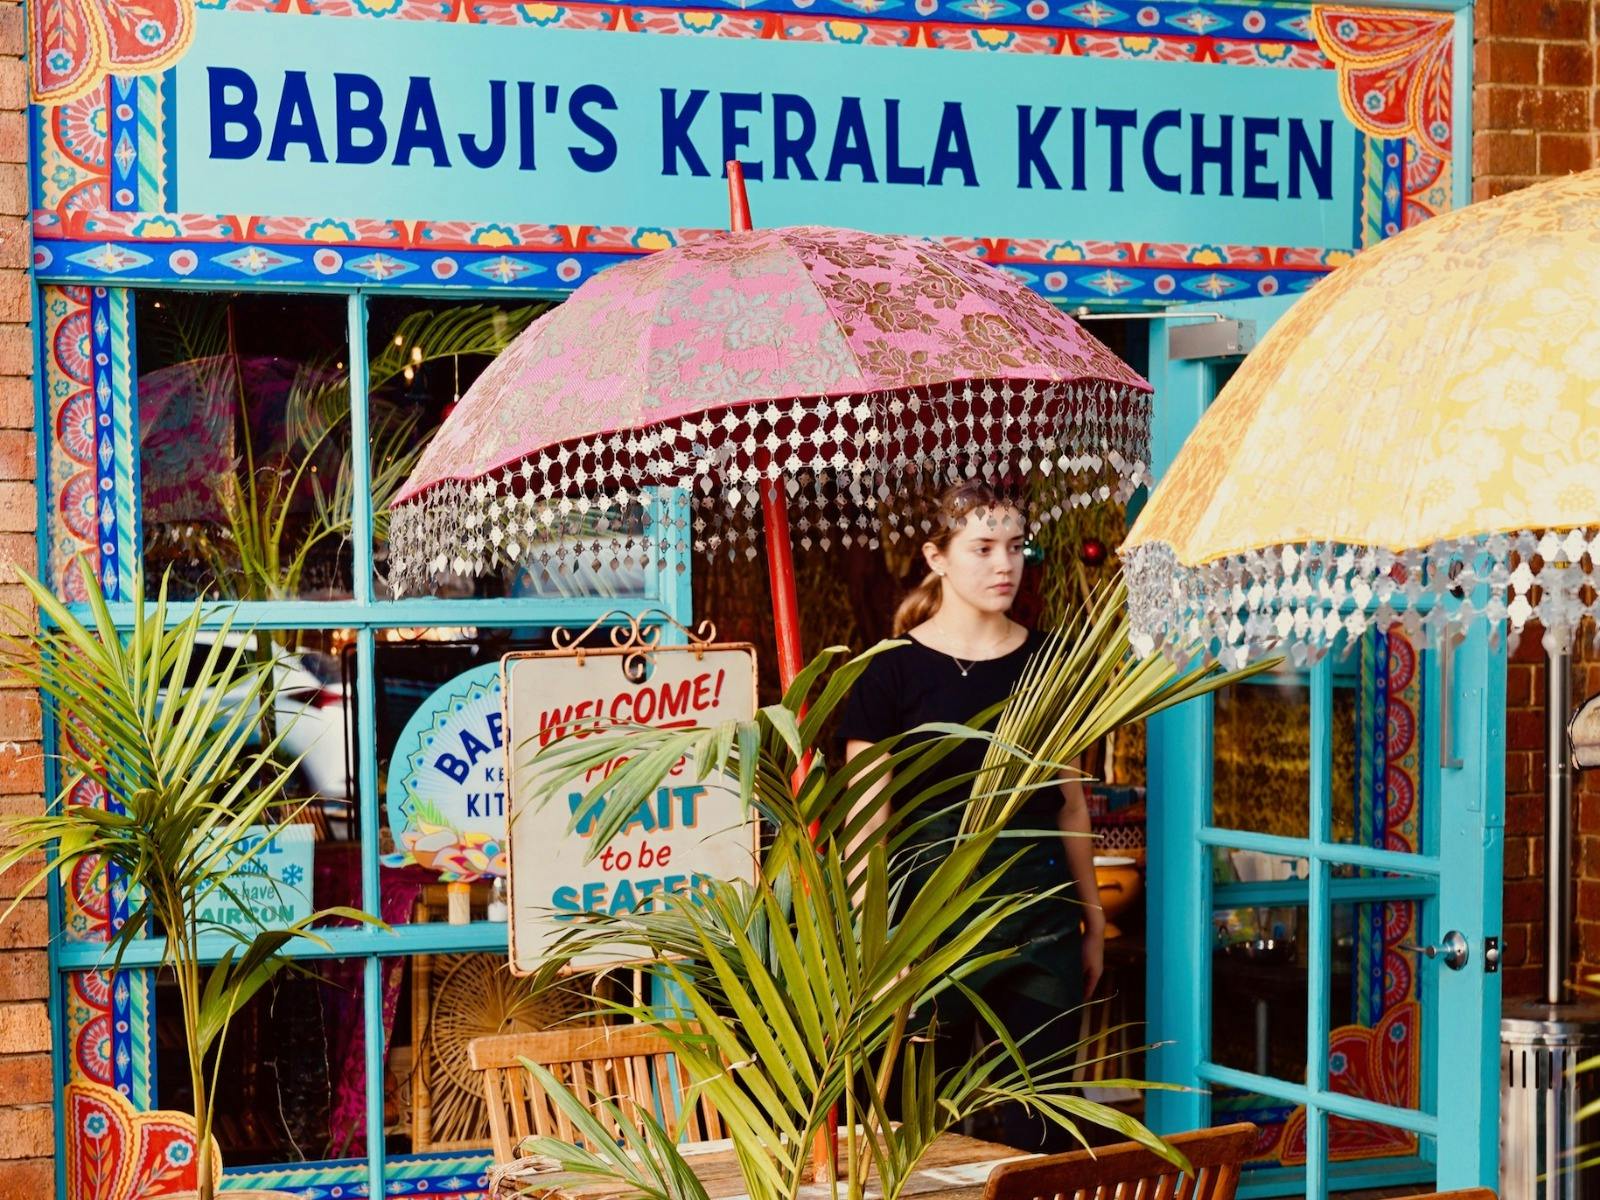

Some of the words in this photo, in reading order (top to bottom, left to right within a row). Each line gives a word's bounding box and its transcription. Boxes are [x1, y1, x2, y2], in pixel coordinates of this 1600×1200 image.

[206, 66, 619, 173] BABAJI'S
[659, 87, 980, 188] KERALA
[1015, 104, 1334, 202] KITCHEN
[539, 668, 725, 747] WELCOME!
[568, 785, 707, 836] WAIT
[600, 846, 632, 872] to
[638, 840, 672, 868] be
[242, 881, 275, 901] have
